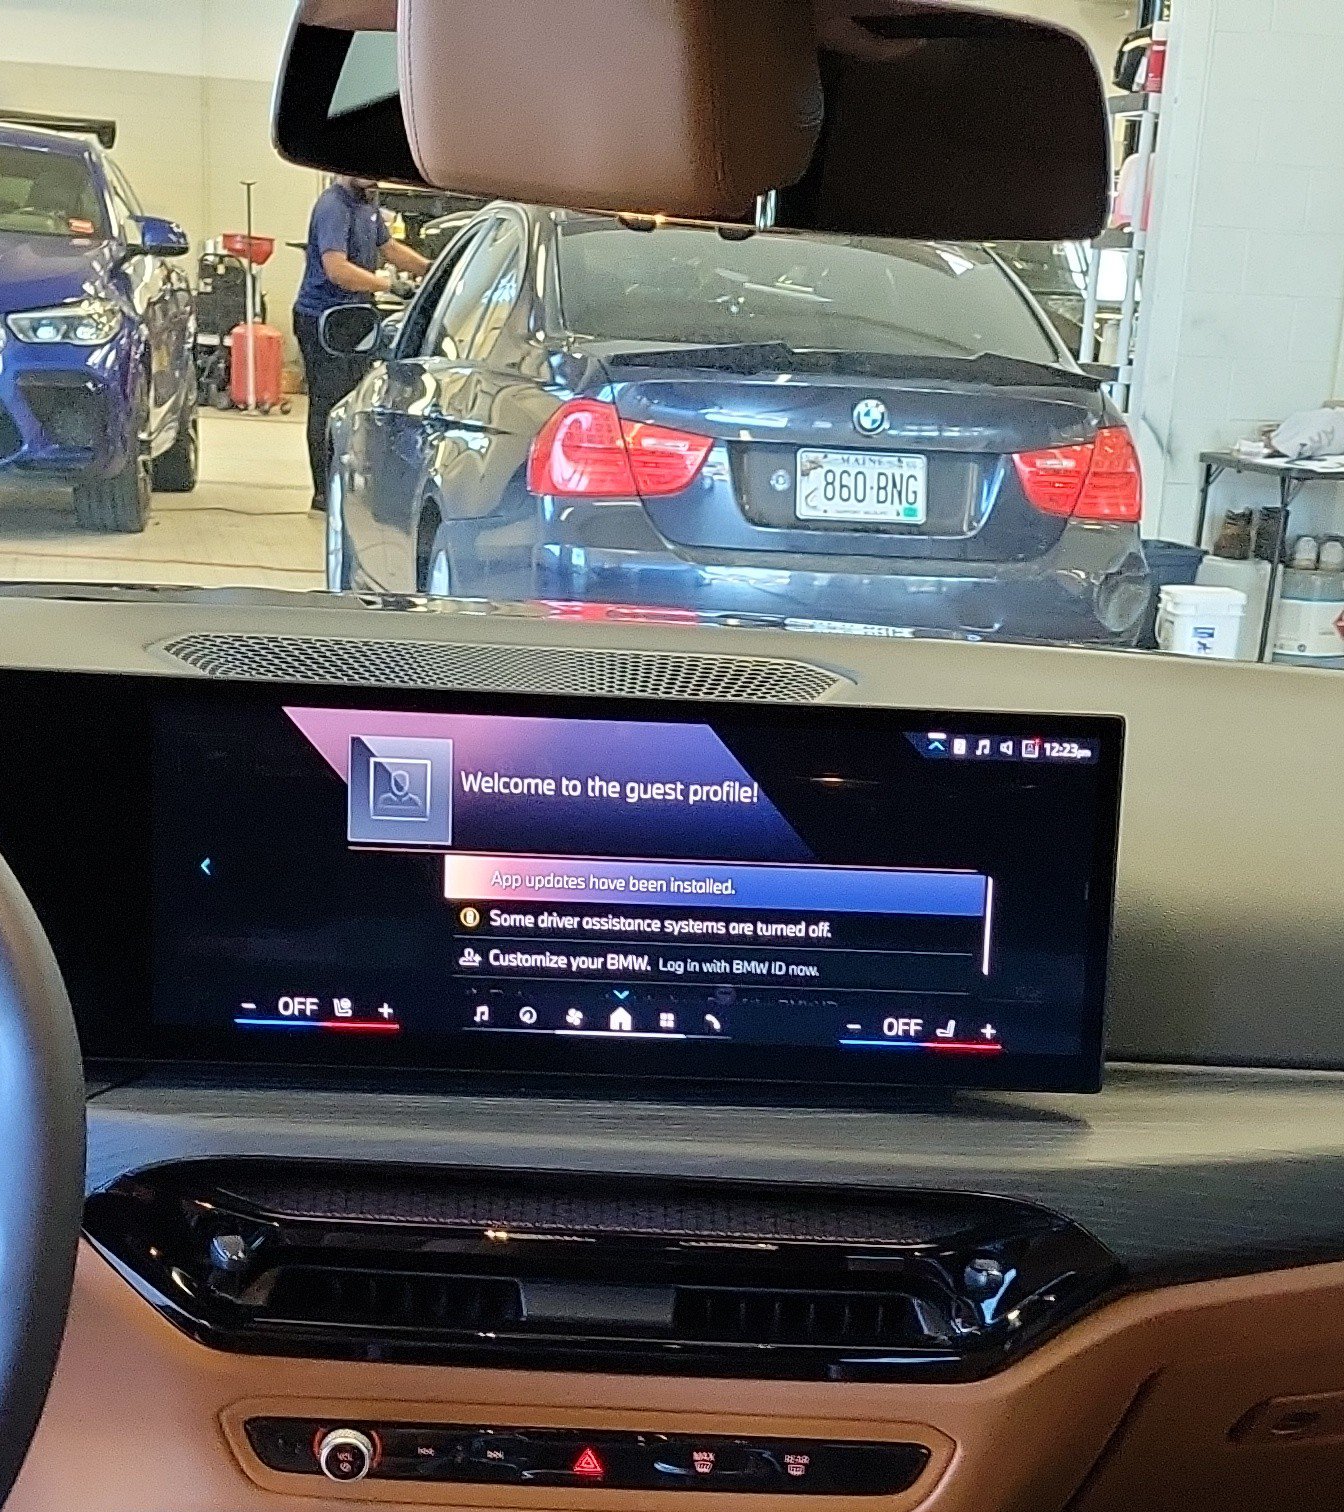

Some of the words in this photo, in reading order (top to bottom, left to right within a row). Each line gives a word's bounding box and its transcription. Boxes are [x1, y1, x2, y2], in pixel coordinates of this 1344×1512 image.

[460, 770, 556, 797] Welcome
[561, 776, 582, 797] to
[587, 776, 620, 798] the
[625, 781, 685, 804] guest
[688, 781, 759, 805] profile!
[491, 870, 523, 890] App
[525, 872, 586, 891] updates
[589, 873, 626, 891] have
[629, 875, 667, 893] been
[670, 876, 736, 896] installed.
[489, 909, 535, 928] Some
[537, 910, 581, 930] driver
[581, 914, 662, 934] assistance
[664, 917, 726, 936] systems
[729, 922, 754, 936] are
[756, 920, 806, 938] turned
[808, 920, 833, 938] off.
[488, 948, 568, 969] Customize
[569, 955, 605, 972] your
[606, 952, 652, 972] BMW.
[658, 956, 684, 975] Log
[687, 957, 700, 972] in
[701, 958, 731, 974] with
[732, 959, 770, 975] BMW
[771, 960, 788, 976] ID
[788, 962, 820, 977] now.
[277, 996, 320, 1017] OFF
[882, 1017, 924, 1037] OFF
